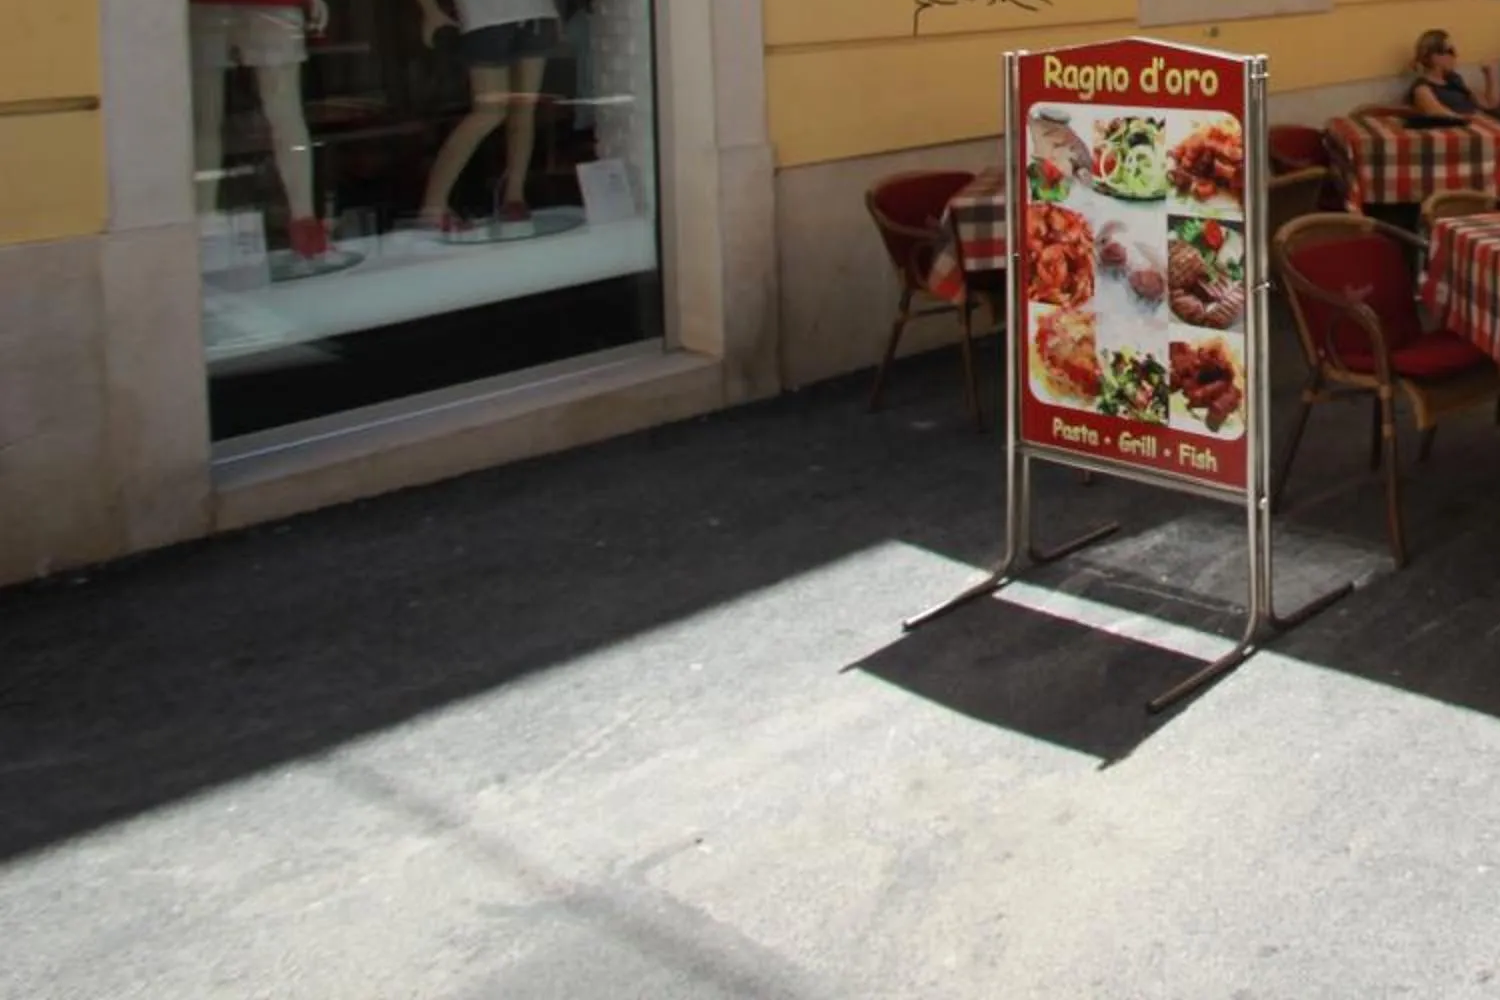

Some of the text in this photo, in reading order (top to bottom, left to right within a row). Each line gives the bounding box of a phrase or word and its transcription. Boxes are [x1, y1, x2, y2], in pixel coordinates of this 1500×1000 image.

[1043, 55, 1219, 100] Ragno d'oro
[1052, 416, 1218, 472] Pasta Grill Fish
